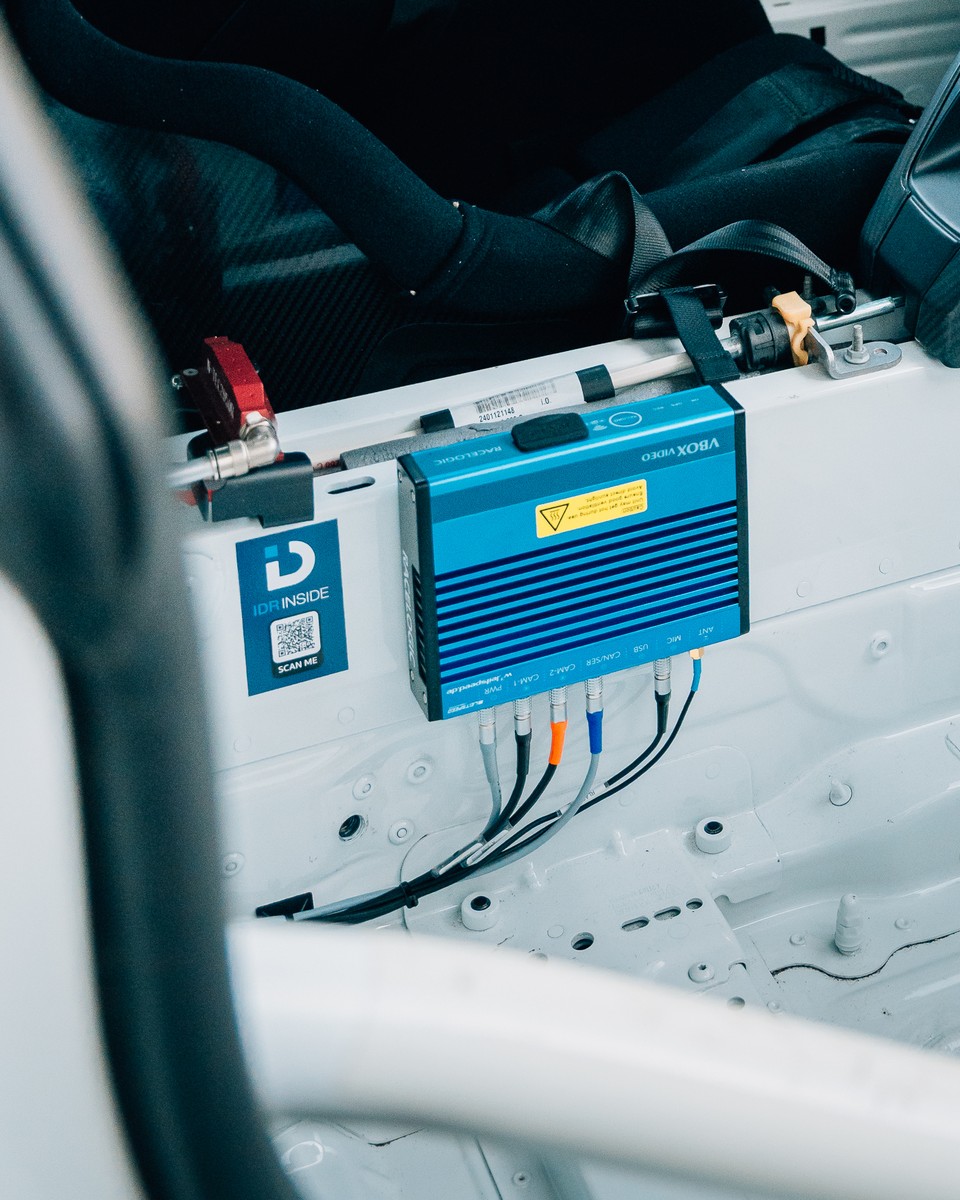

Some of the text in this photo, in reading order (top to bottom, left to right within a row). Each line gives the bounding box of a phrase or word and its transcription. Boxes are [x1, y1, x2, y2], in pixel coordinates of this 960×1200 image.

[479, 407, 515, 422] 2401121148
[433, 446, 502, 466] RACELOGIC
[641, 437, 720, 462] VBOX VIDEO
[253, 586, 330, 617] IDR INSIDE
[698, 626, 714, 636] ANT
[667, 635, 682, 644] MIC
[633, 643, 649, 653] USB
[278, 657, 318, 674] SCAN ME
[586, 651, 621, 666] CAN/SER
[549, 663, 576, 676] CAM-2
[513, 673, 540, 687] CAM-1
[484, 685, 503, 695] PWR
